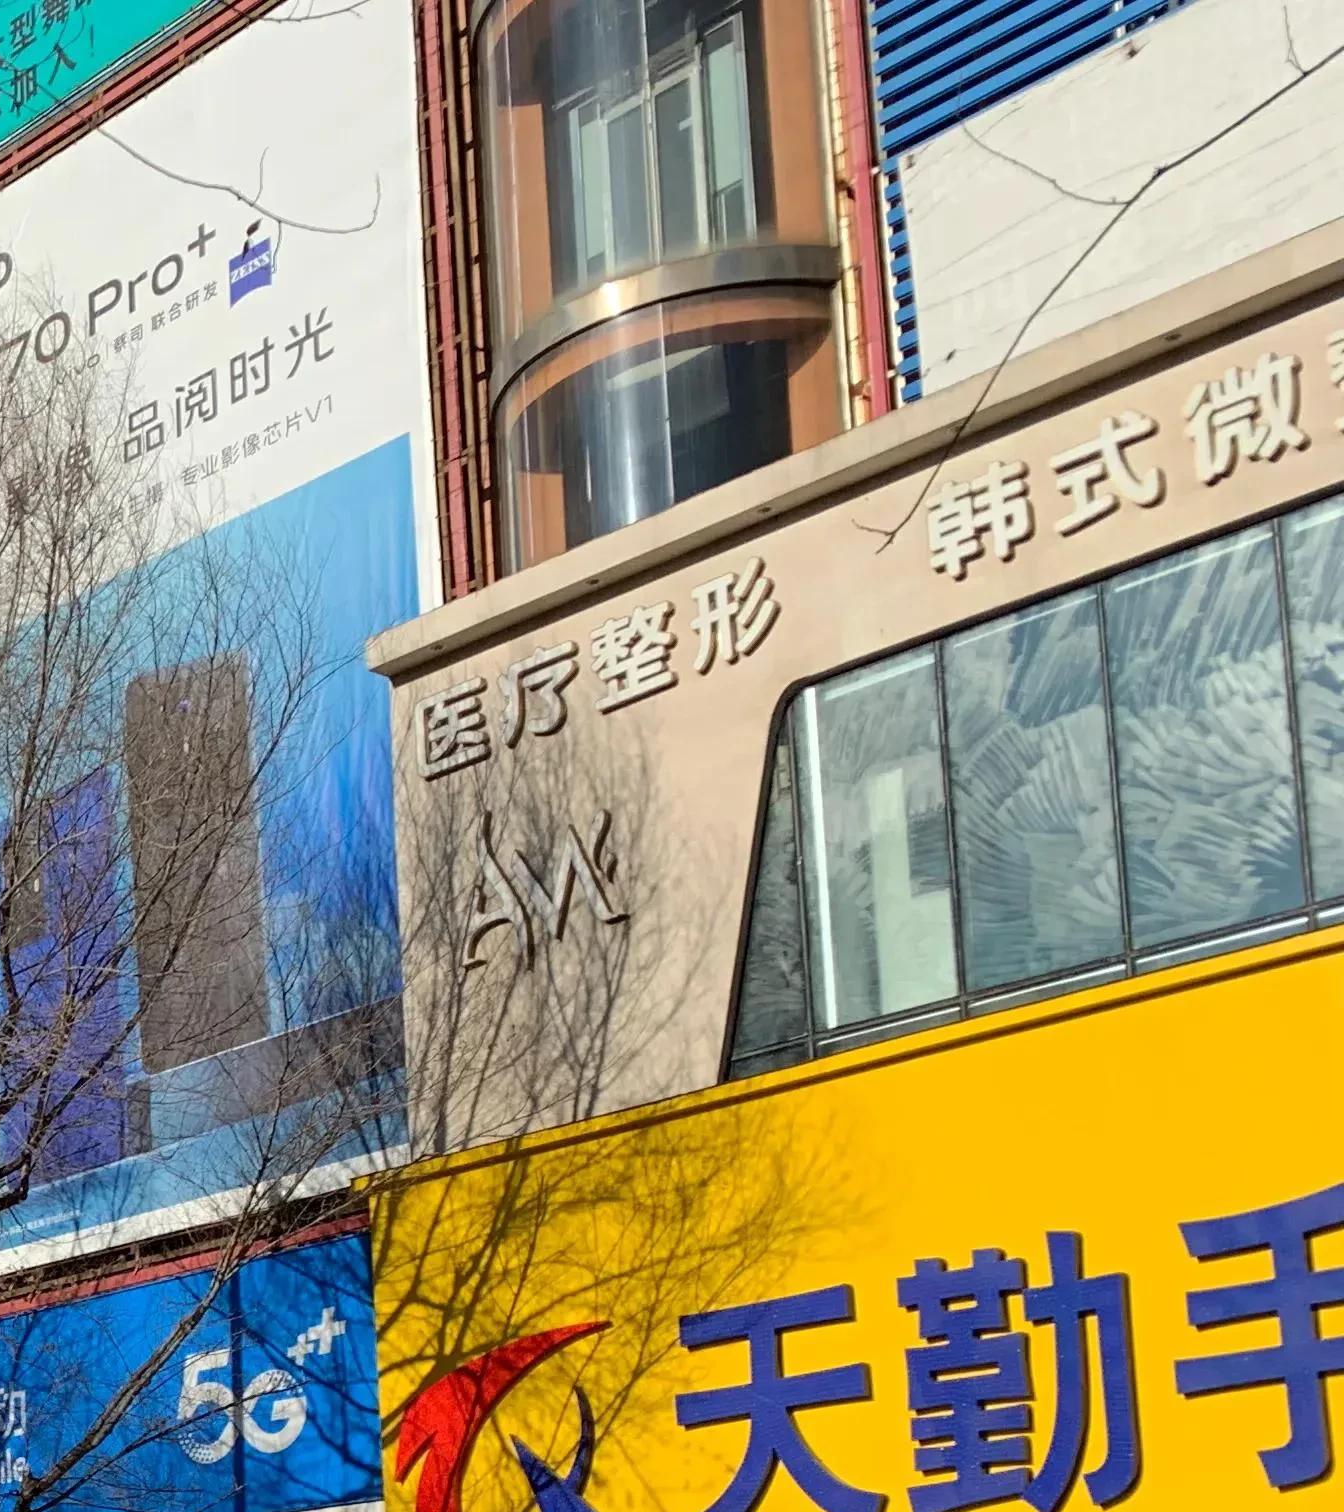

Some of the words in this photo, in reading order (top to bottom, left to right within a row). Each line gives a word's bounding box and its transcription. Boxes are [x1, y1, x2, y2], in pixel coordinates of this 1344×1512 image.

[123, 306, 335, 463] 品阅时光
[926, 325, 1344, 580] 韩式微
[416, 557, 783, 782] 医疗整形
